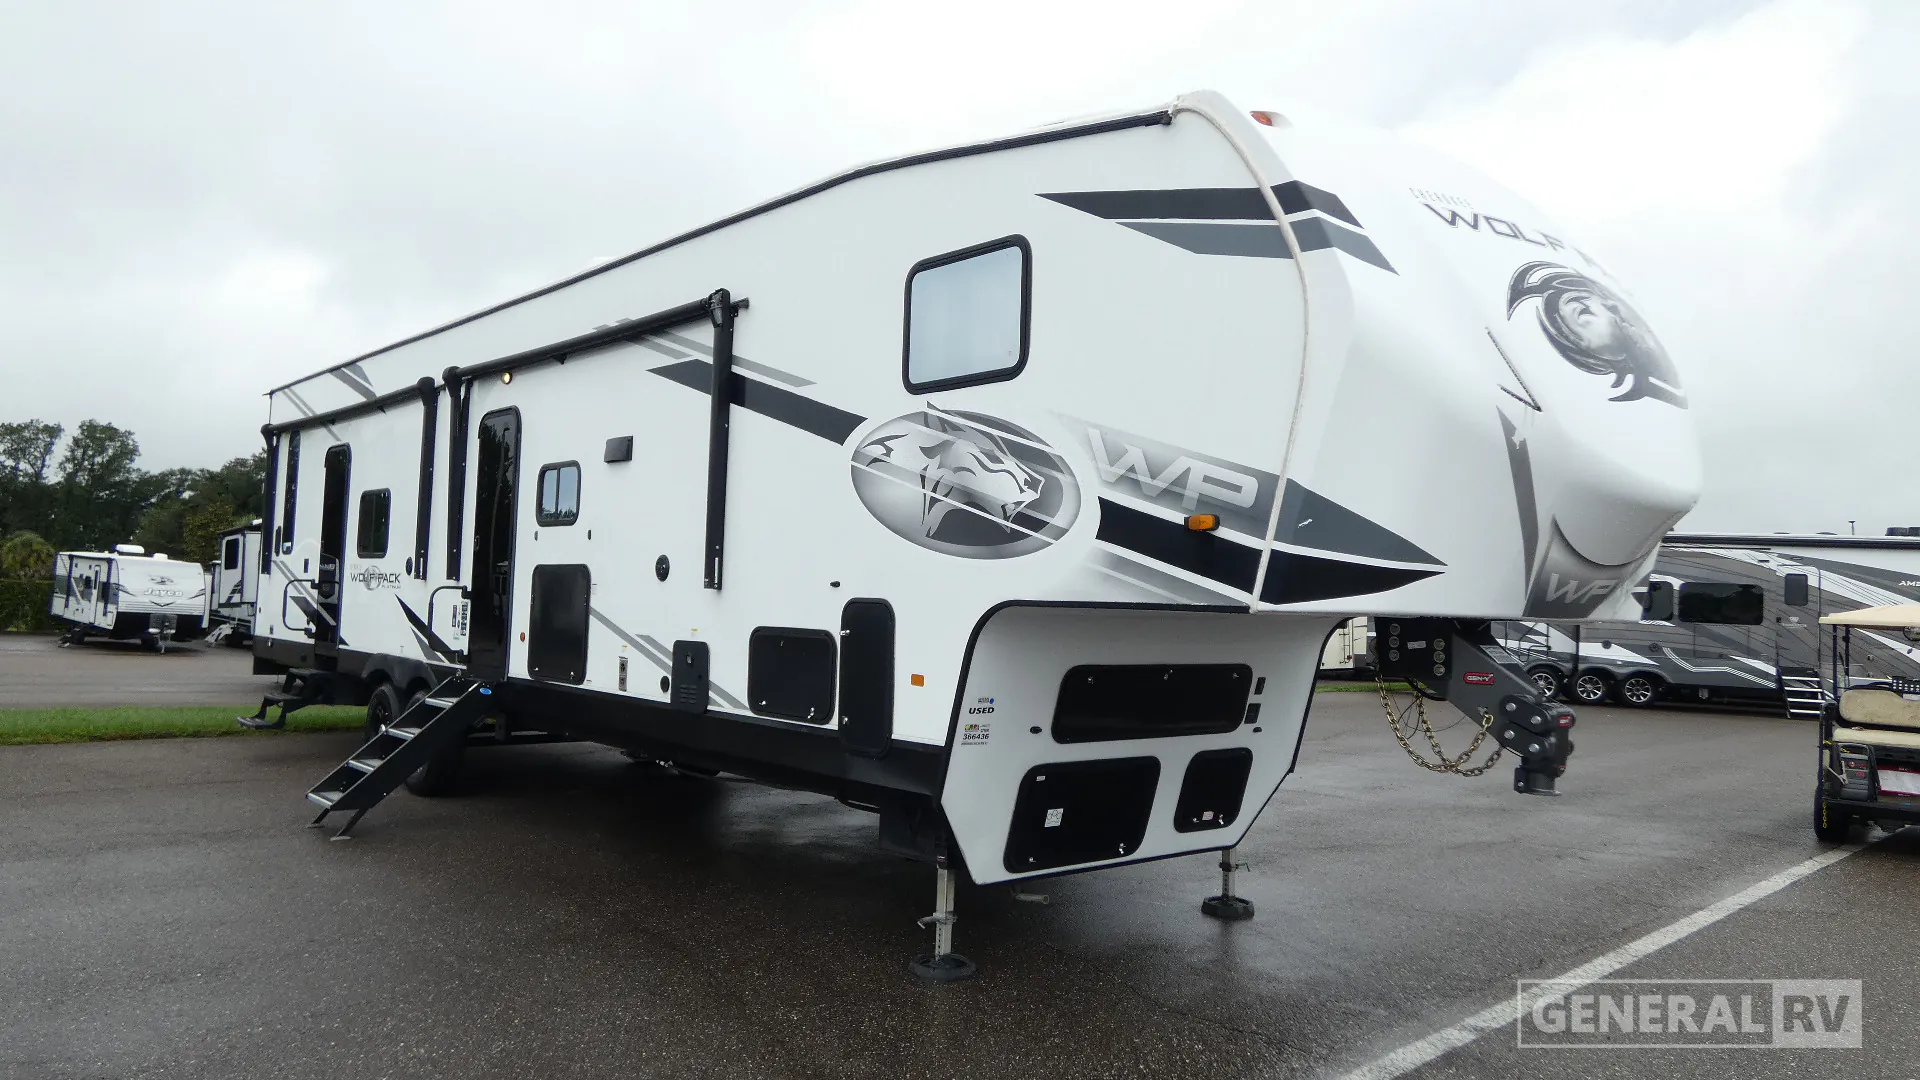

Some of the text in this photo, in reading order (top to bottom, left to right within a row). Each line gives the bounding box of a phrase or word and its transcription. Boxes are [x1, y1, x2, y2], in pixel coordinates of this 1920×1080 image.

[1420, 201, 1565, 252] WOLF
[1087, 426, 1259, 511] WP
[144, 588, 183, 597] Jayco
[350, 572, 401, 584] WOLF PACK
